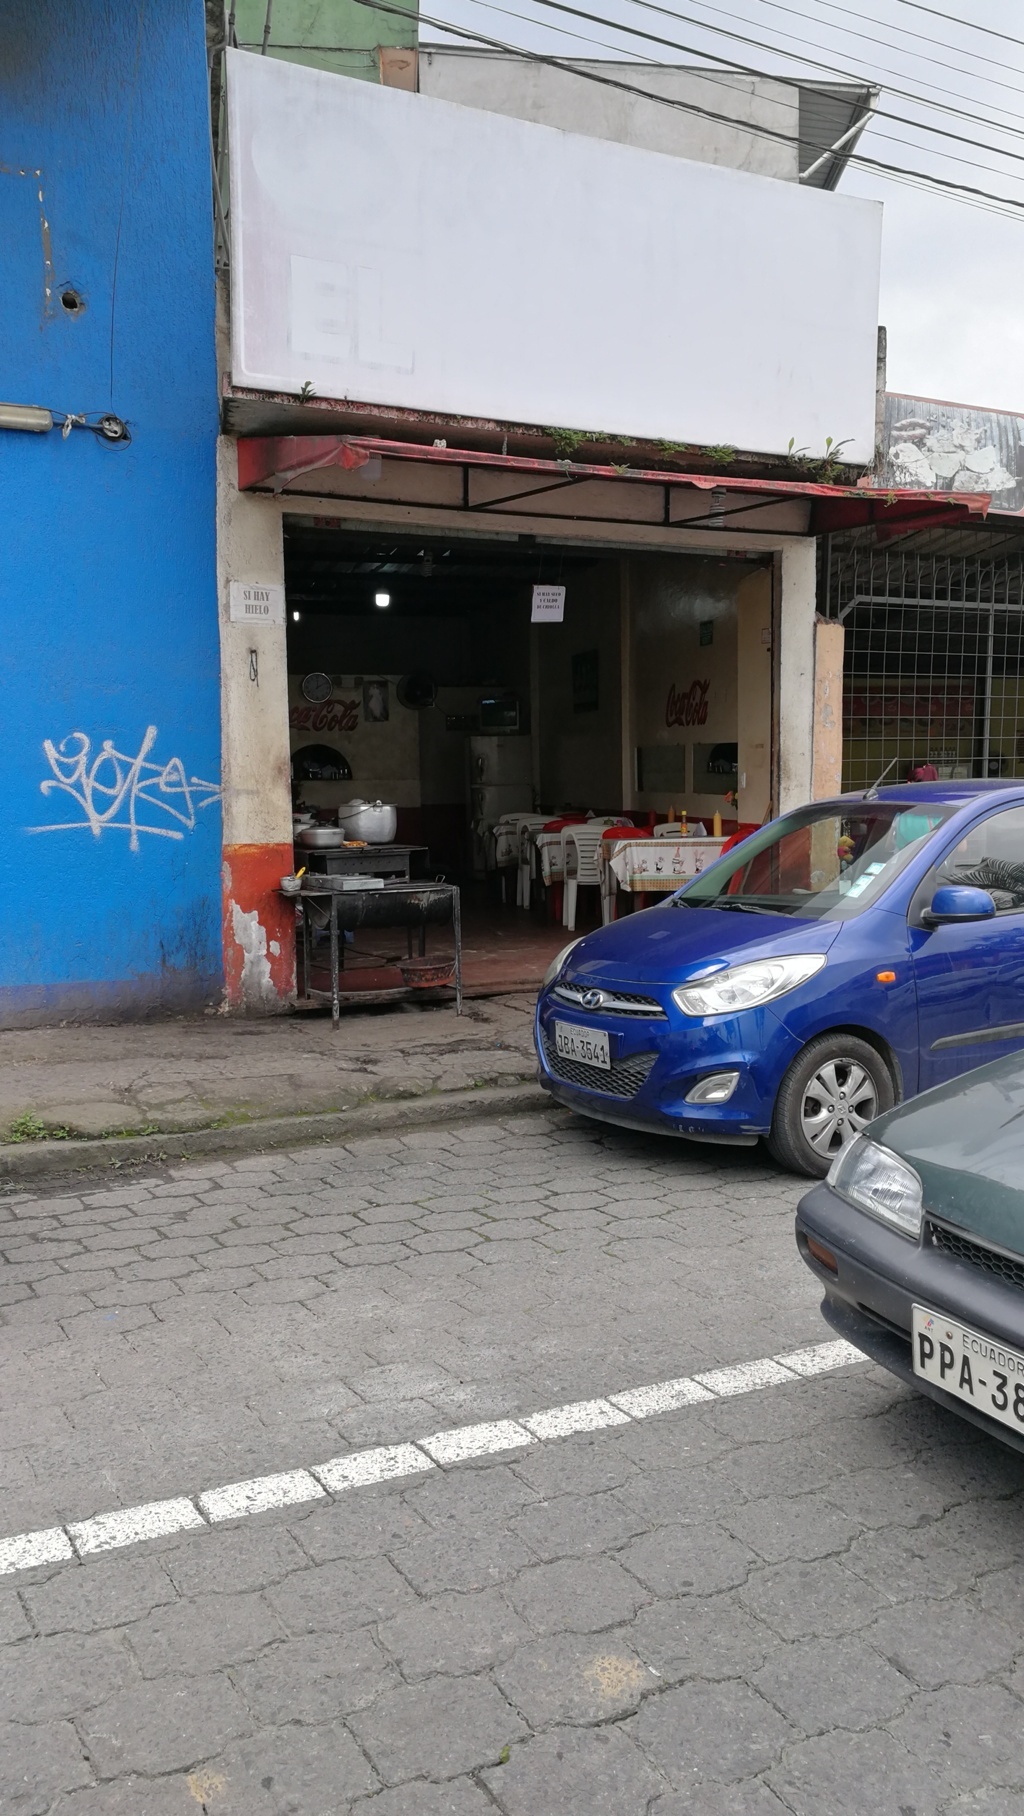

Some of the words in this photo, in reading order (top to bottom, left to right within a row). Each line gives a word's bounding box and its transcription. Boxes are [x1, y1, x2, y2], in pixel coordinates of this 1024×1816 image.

[243, 590, 251, 601] SI
[253, 590, 270, 602] HAY
[244, 603, 269, 615] HIELO
[557, 1034, 607, 1064] JBA-3541
